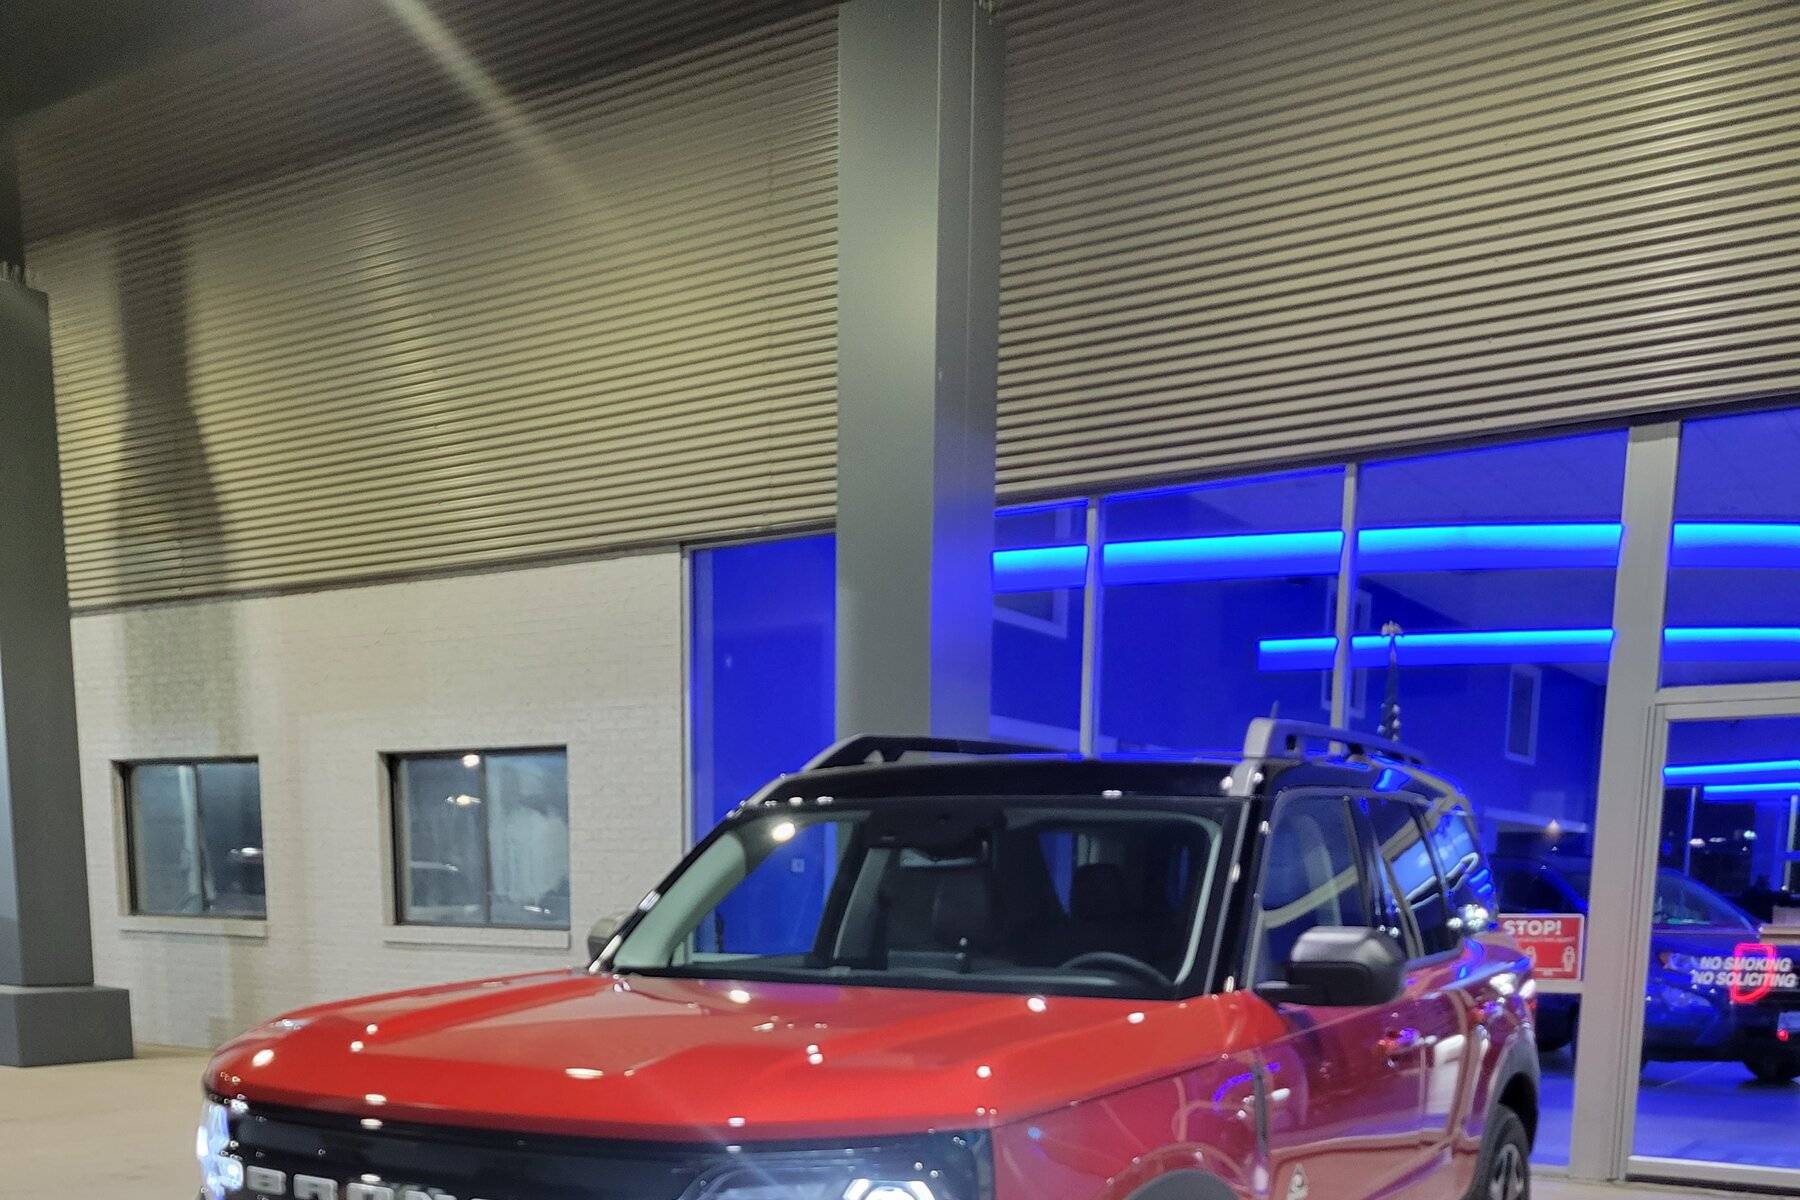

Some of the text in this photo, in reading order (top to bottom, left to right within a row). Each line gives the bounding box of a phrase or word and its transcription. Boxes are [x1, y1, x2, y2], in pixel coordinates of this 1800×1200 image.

[1502, 919, 1562, 936] STOP!
[1700, 956, 1793, 972] NO SMOKING
[1692, 970, 1798, 988] NO SOLICITING
